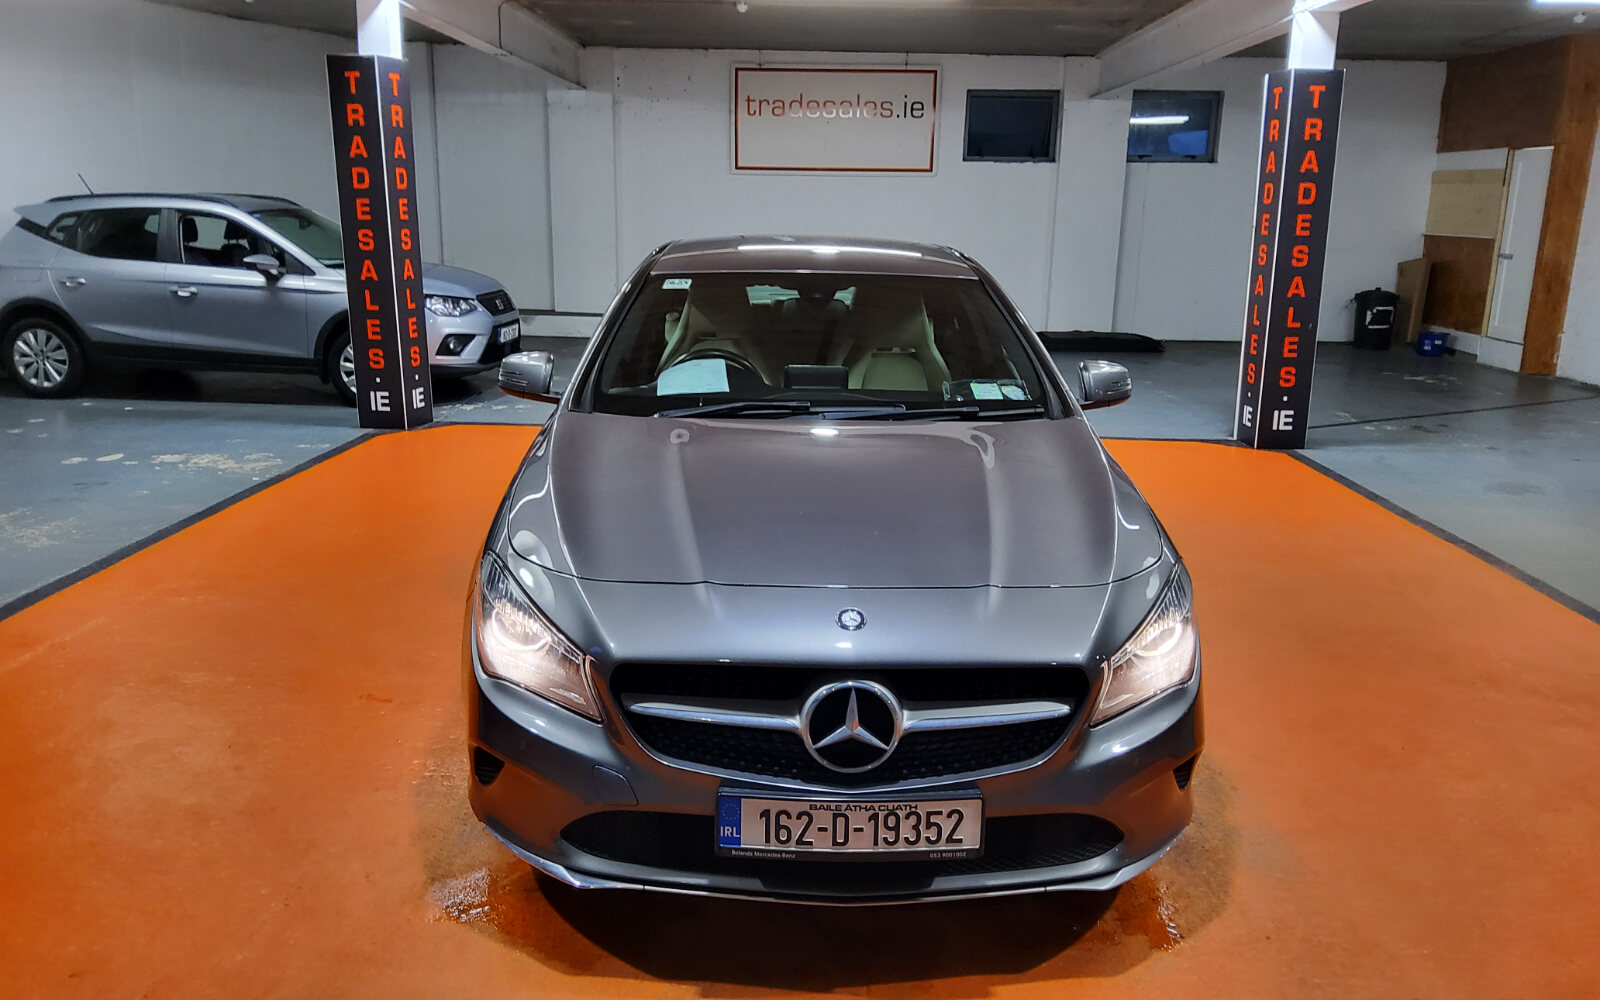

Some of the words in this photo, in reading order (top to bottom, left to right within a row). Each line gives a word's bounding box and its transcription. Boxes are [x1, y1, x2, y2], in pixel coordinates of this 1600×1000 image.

[745, 93, 925, 119] tradesales.ie
[809, 804, 842, 812] BAILE
[878, 804, 918, 812] CLIATH
[720, 826, 741, 838] IRL
[759, 808, 965, 847] 162-D-19352
